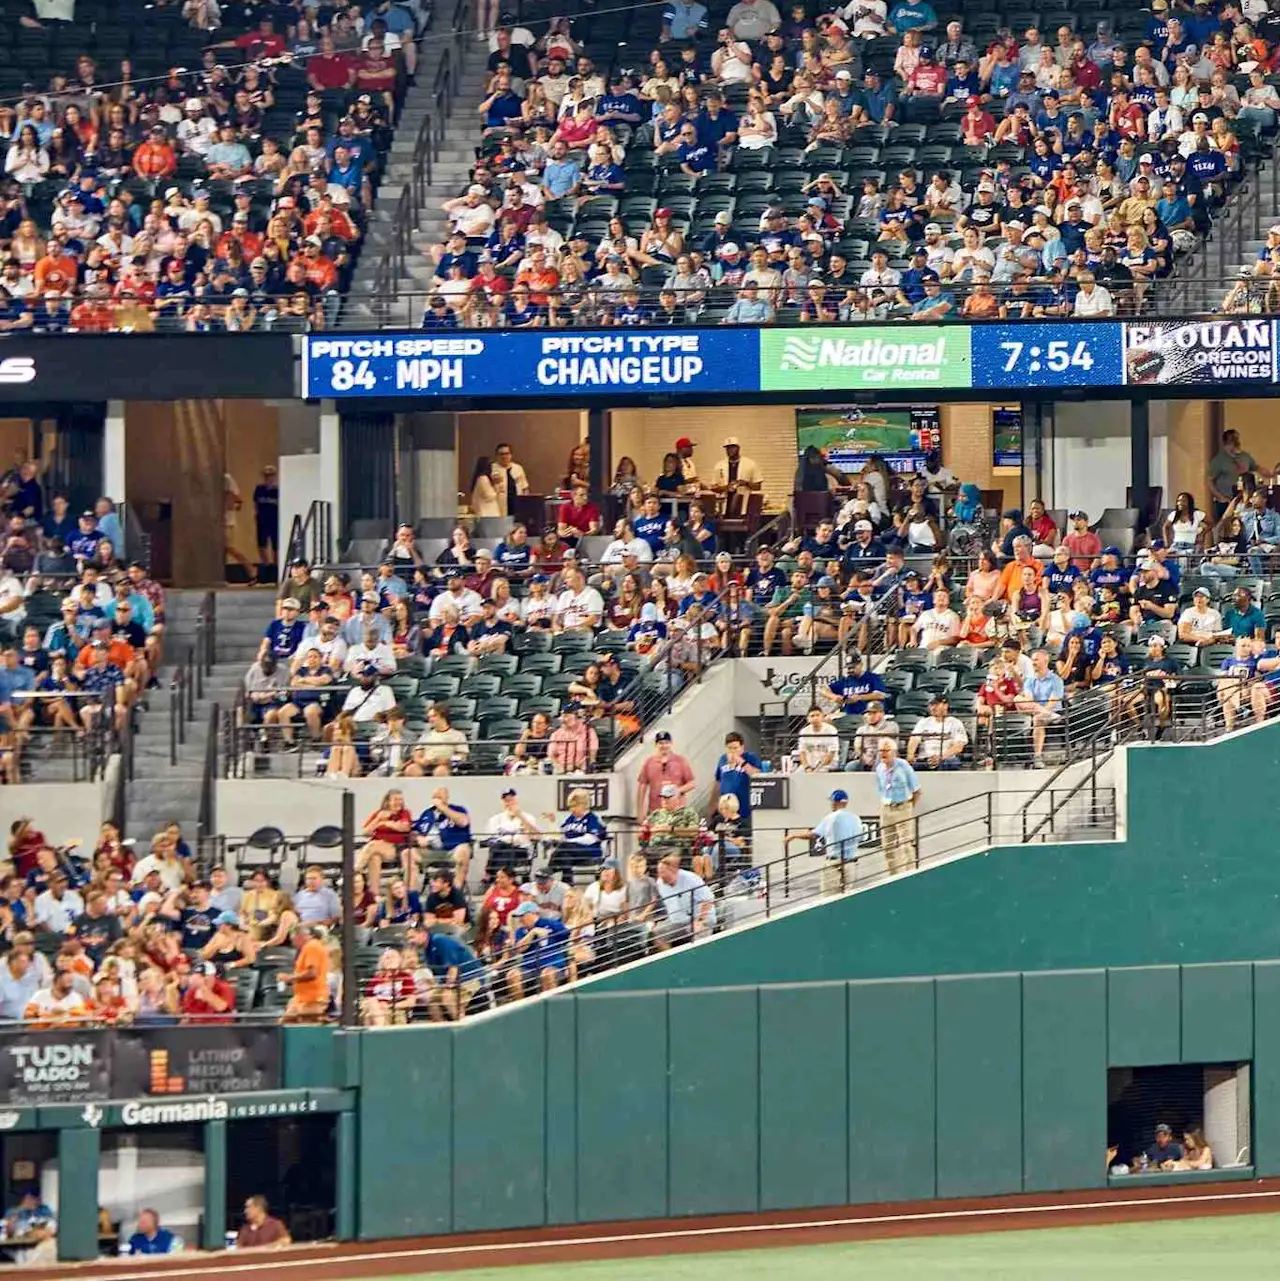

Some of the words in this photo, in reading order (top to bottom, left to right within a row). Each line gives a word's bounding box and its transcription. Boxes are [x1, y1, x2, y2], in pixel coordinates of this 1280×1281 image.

[1192, 161, 1215, 171] TEXAS
[541, 336, 614, 353] PITCH
[627, 335, 699, 353] TYPE
[1128, 323, 1271, 349] ELOUAN
[311, 339, 394, 358] PITCH
[395, 338, 484, 357] SPEED
[819, 338, 946, 367] National
[1002, 341, 1094, 371] 7:54
[1195, 351, 1270, 365] OREGON
[331, 359, 376, 390] 84
[397, 357, 463, 390] MPH
[536, 355, 703, 386] CHANGEUP
[862, 369, 889, 382] Car
[892, 368, 940, 381] Rental
[1212, 363, 1271, 379] WINES
[637, 522, 662, 534] TEXAS
[494, 897, 510, 910] T
[9, 1044, 94, 1068] TUDN
[188, 1049, 244, 1064] LATINO
[23, 1067, 79, 1083] RADIO
[121, 1098, 228, 1126] Germania
[230, 1099, 319, 1118] INSURANCE
